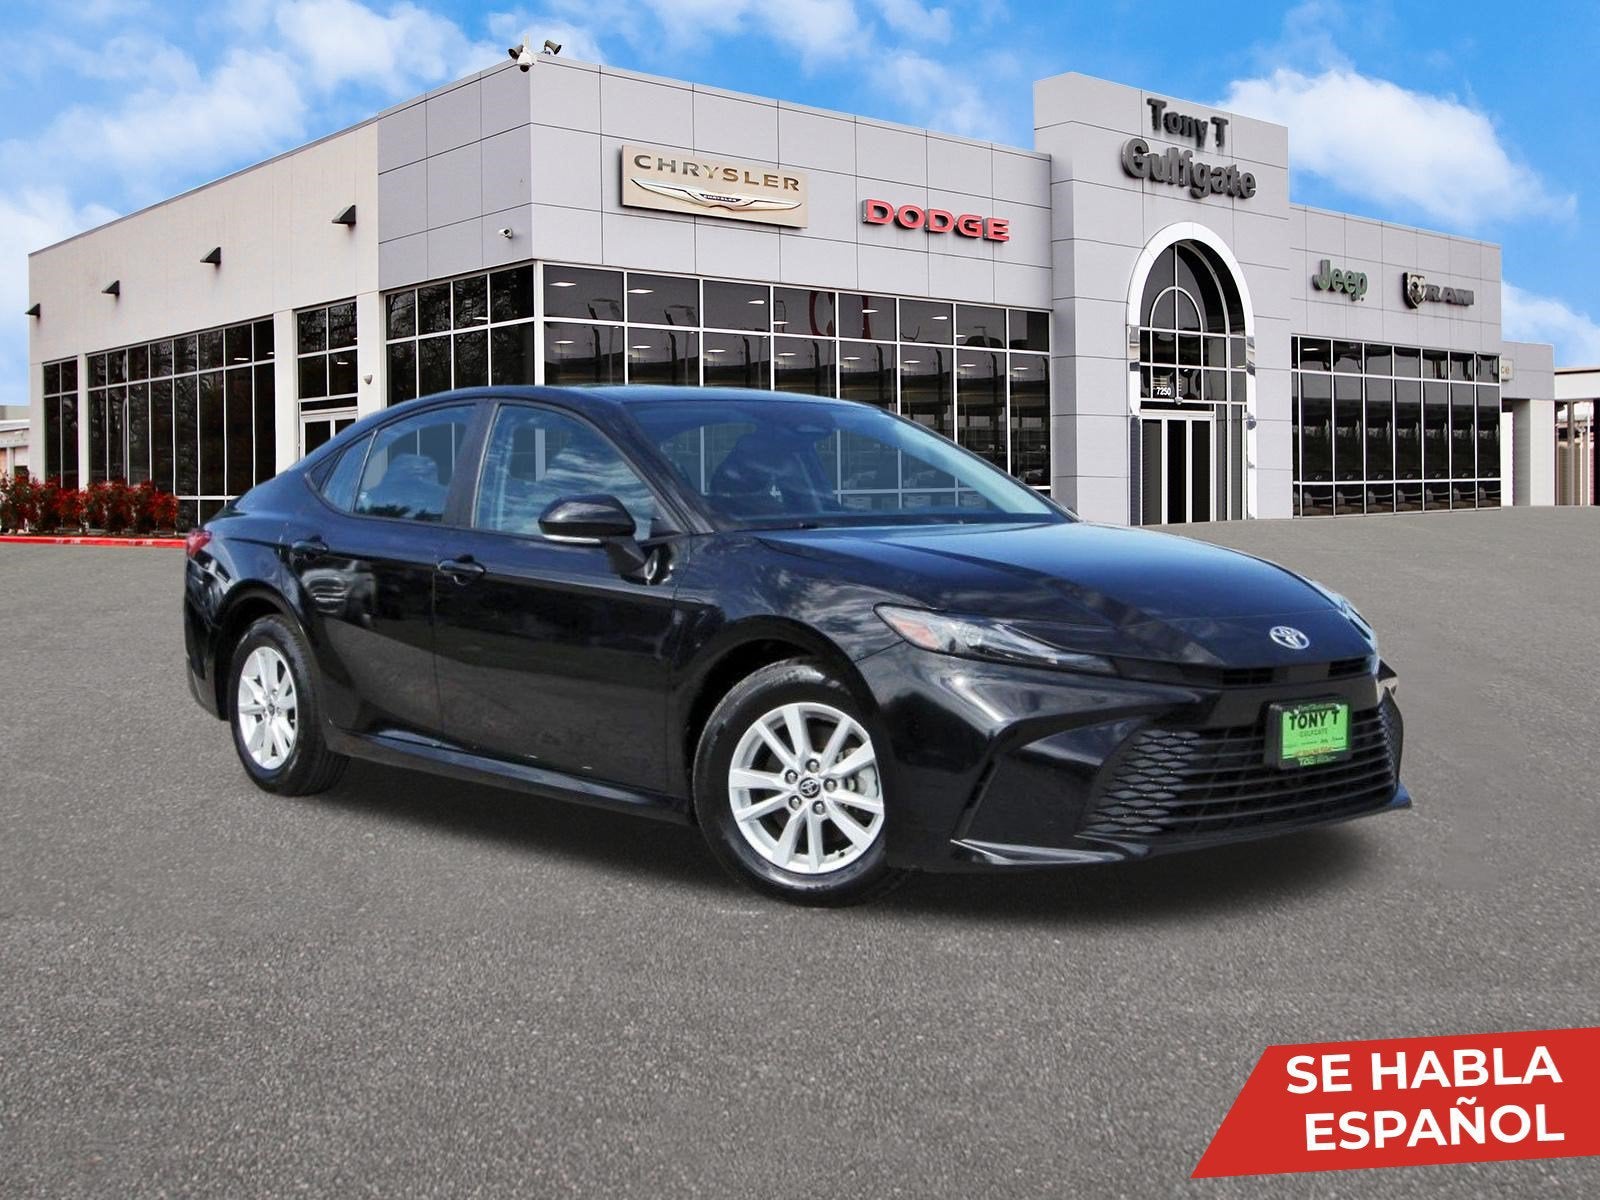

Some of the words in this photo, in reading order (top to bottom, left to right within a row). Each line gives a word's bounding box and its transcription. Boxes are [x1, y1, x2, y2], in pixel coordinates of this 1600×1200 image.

[1146, 98, 1208, 148] Tony
[1210, 116, 1229, 147] T
[633, 153, 801, 192] CHRYSLER
[1120, 138, 1256, 199] Gulfgate
[862, 199, 1010, 242] DODGE
[1312, 259, 1367, 301] Jeep
[1424, 283, 1474, 306] RAM
[1156, 386, 1171, 396] 7250
[1289, 711, 1328, 731] TONY
[1331, 709, 1340, 725] T
